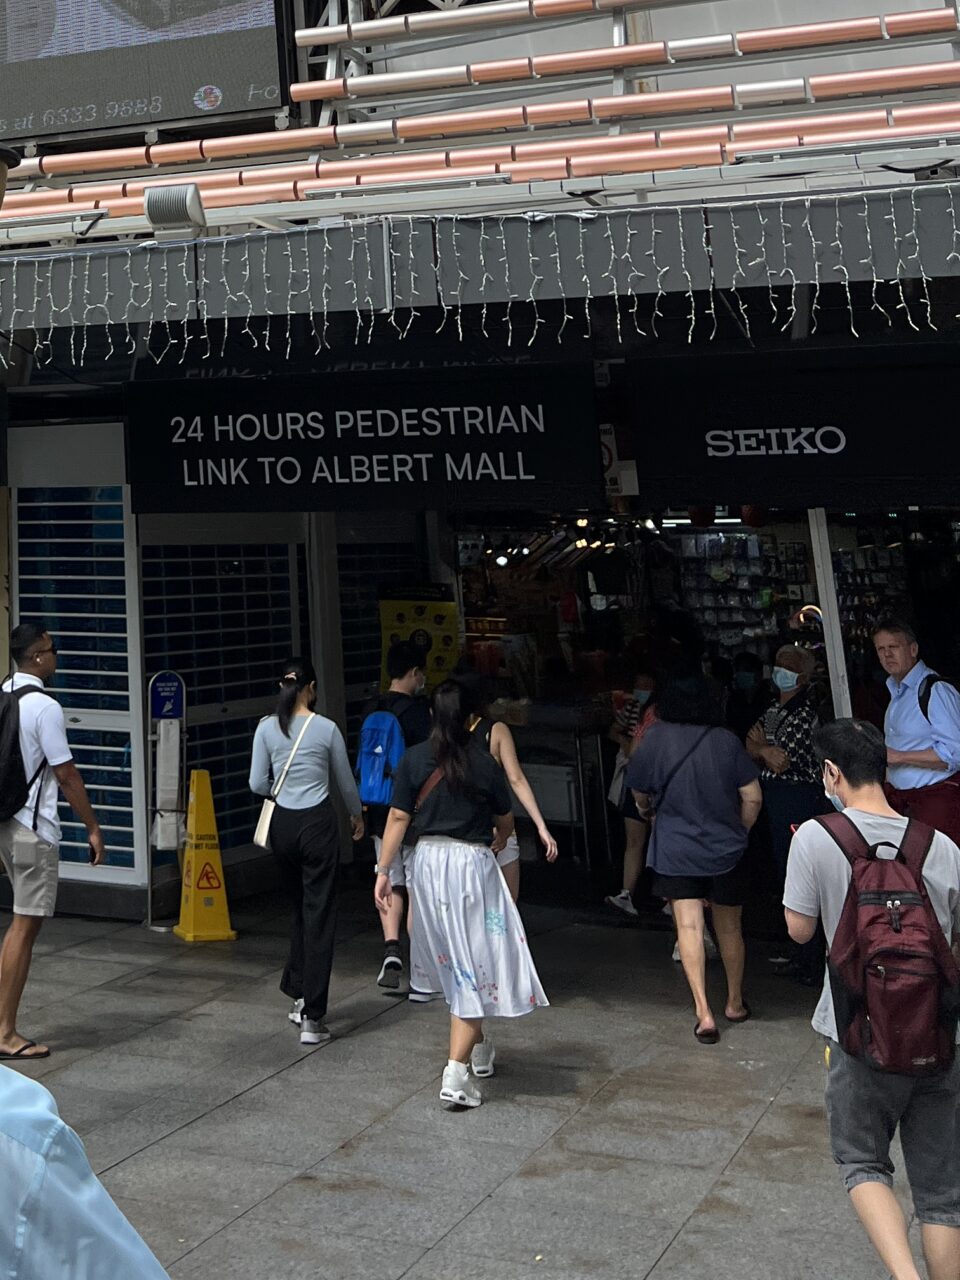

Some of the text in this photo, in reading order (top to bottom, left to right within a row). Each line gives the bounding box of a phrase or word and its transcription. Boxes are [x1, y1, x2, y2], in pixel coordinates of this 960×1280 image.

[170, 404, 546, 444] 24 HOURS PEDESTRIAN
[705, 426, 847, 457] SEIKO
[183, 451, 536, 486] LINK TO ALBERT MALL
